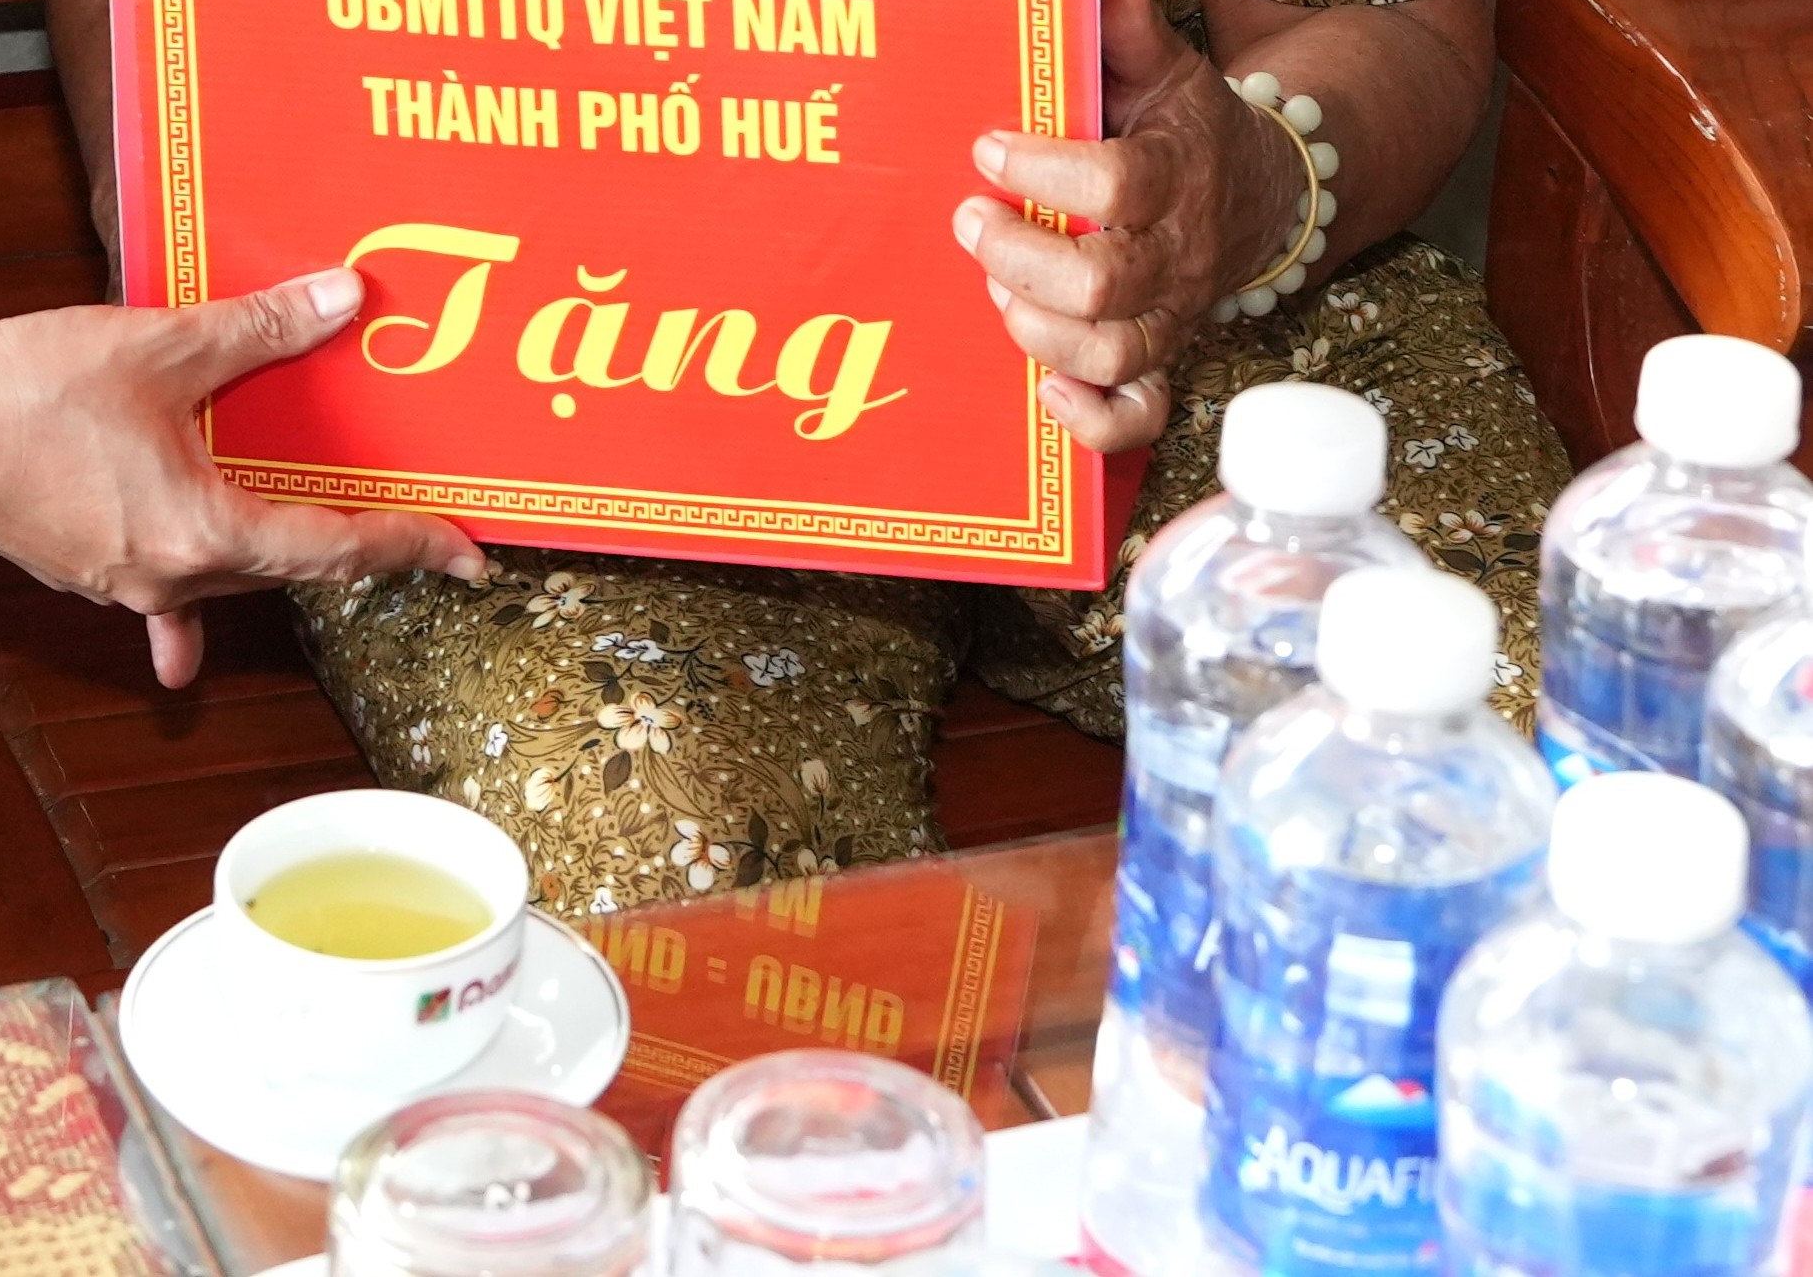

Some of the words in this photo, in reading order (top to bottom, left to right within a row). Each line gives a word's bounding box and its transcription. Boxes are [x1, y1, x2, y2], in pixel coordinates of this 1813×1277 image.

[363, 69, 559, 148] THÀNH
[579, 72, 701, 156] PHỐ
[722, 83, 843, 164] HUẾ
[344, 223, 908, 441] Tặng
[1250, 1123, 1437, 1215] AQUAFI
